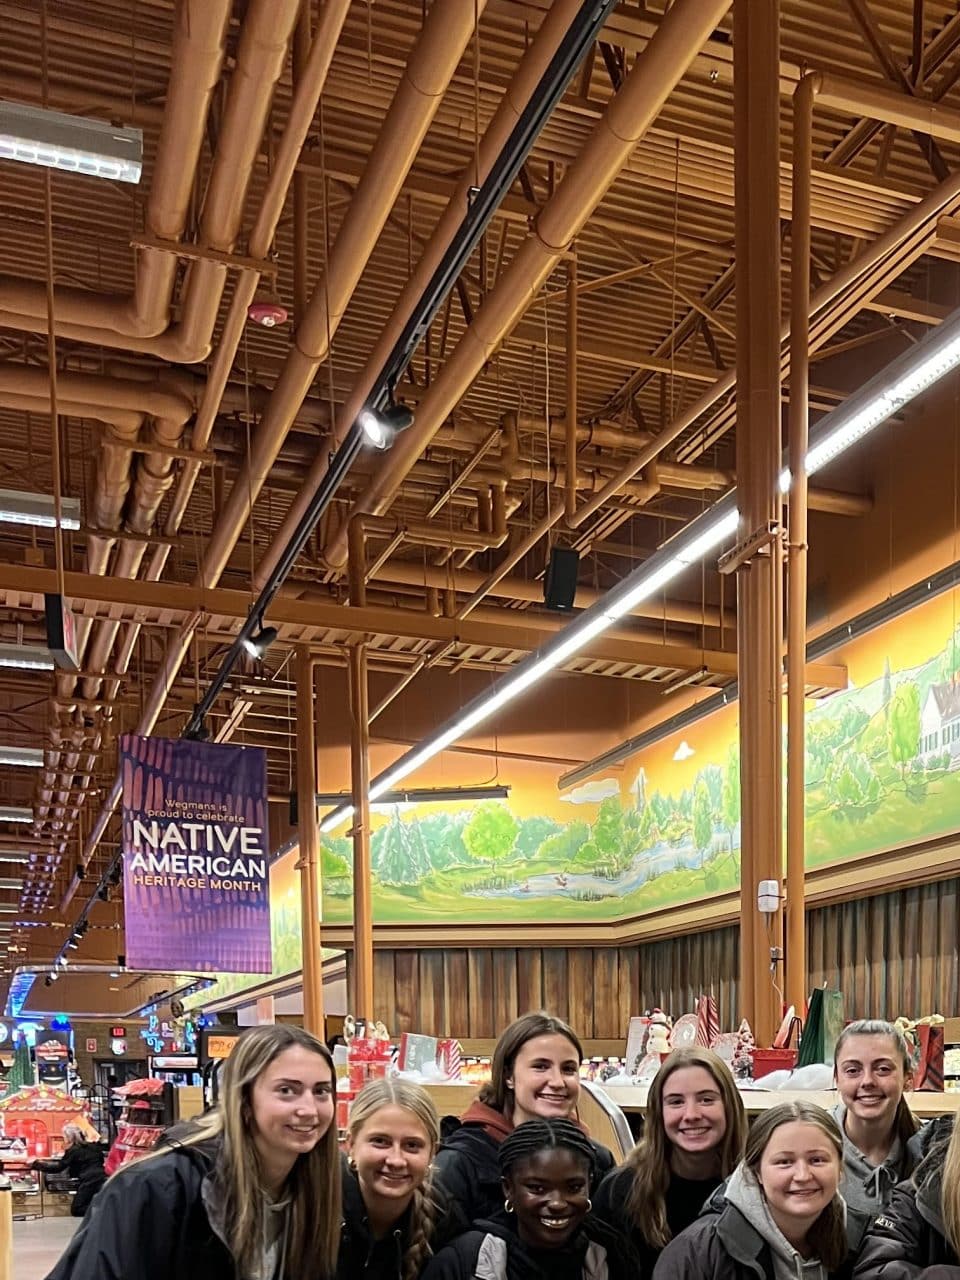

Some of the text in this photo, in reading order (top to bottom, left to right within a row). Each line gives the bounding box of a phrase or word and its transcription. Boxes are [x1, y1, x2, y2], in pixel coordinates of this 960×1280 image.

[165, 799, 228, 814] Wegmans is
[147, 809, 245, 823] proud to celebrate
[133, 820, 263, 855] NATIVE
[130, 852, 266, 879] AMERICAN
[134, 875, 261, 892] HERITAGE MONTH
